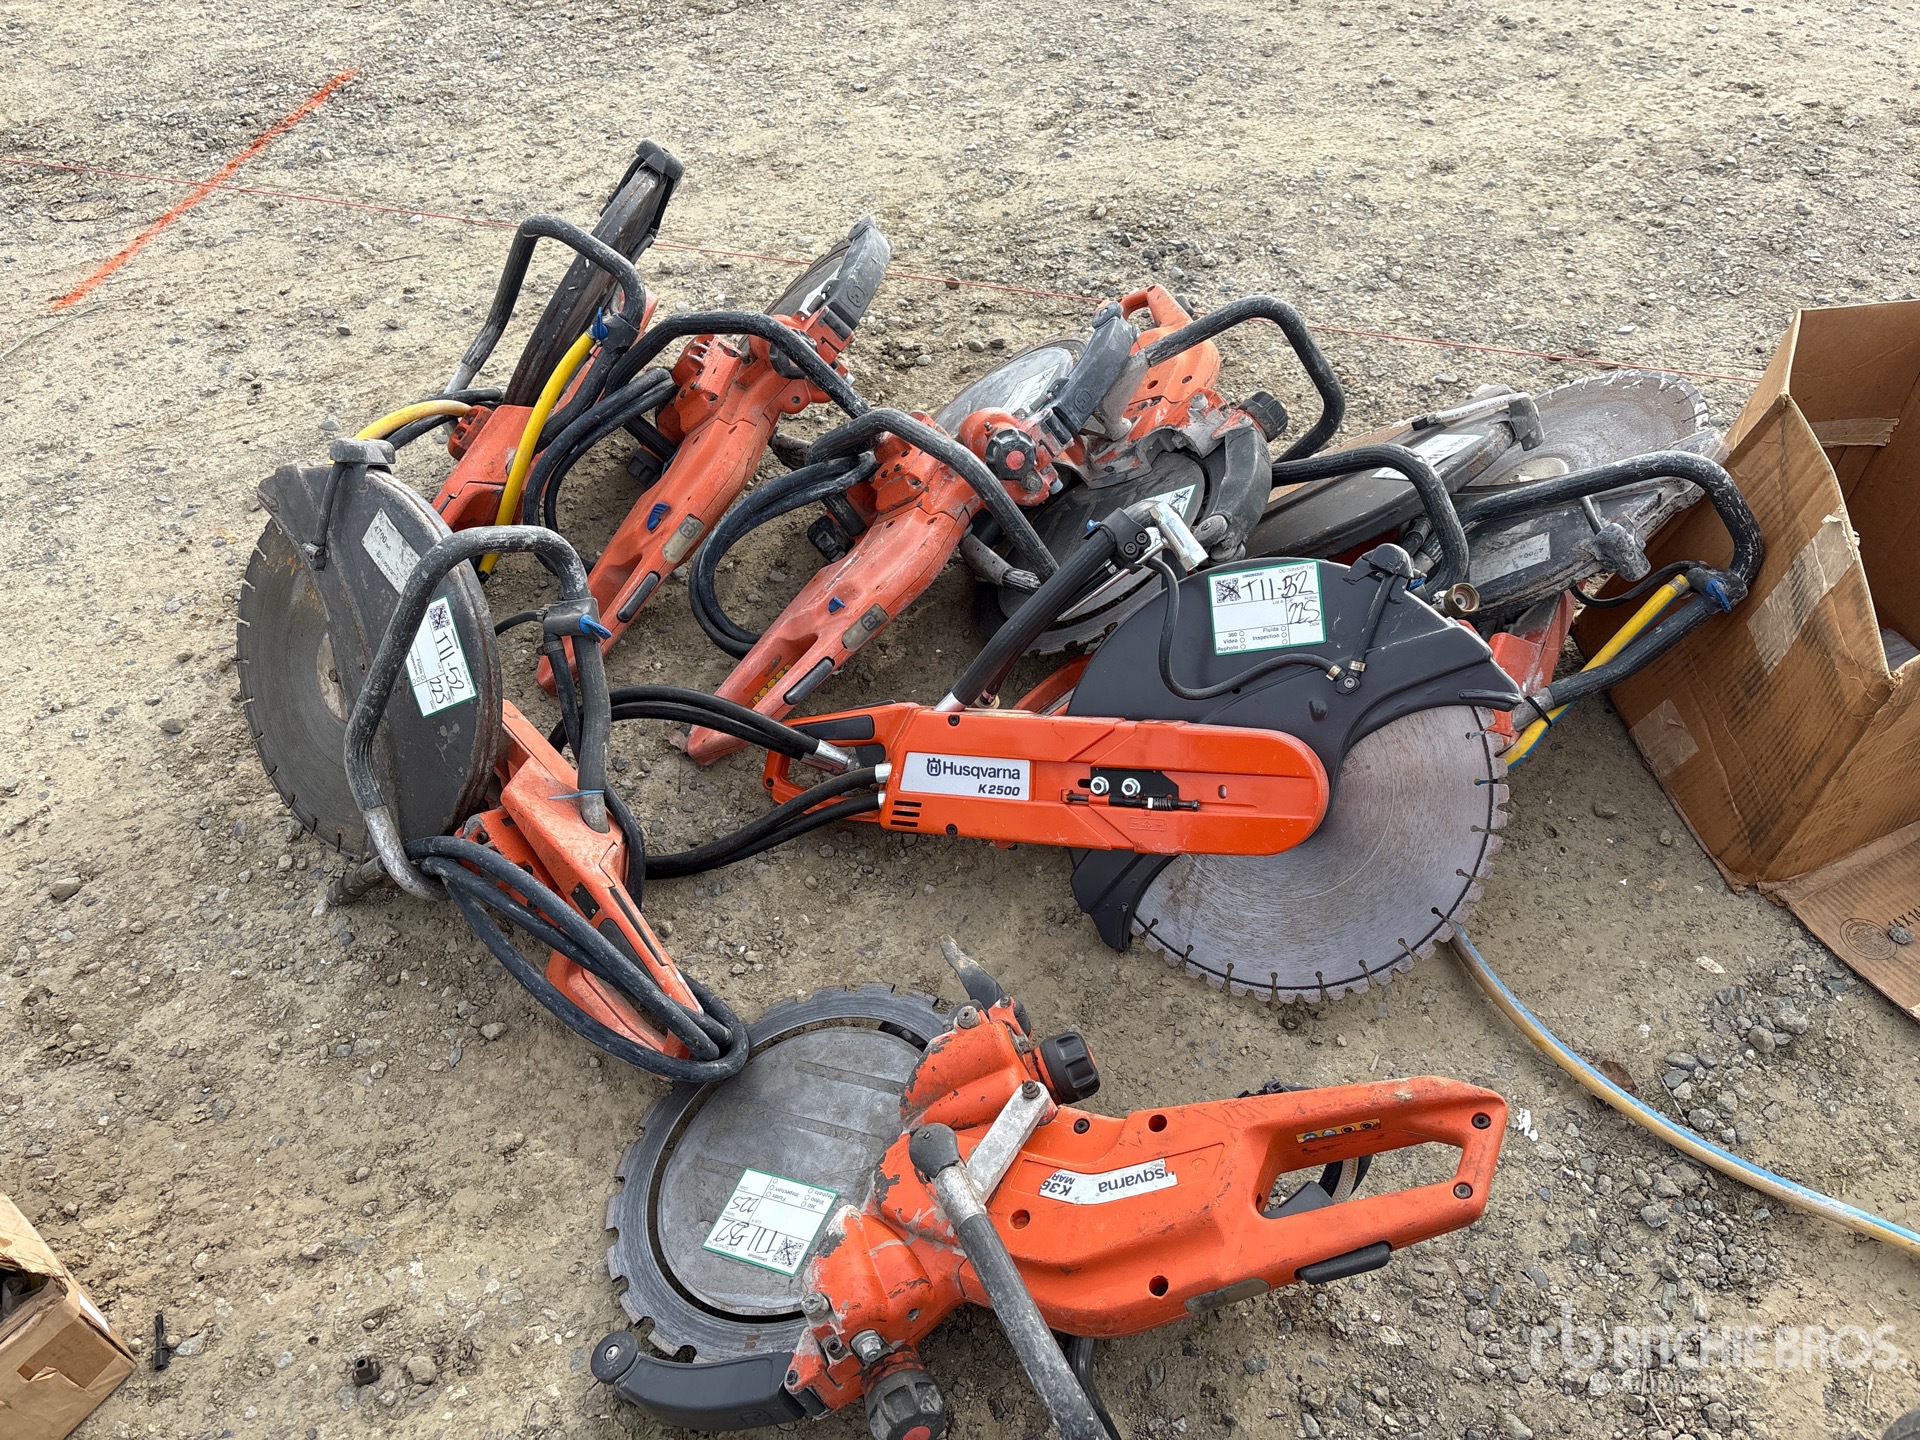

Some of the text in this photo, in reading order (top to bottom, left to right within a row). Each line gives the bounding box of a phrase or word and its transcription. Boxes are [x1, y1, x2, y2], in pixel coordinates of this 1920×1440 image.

[436, 631, 464, 696] T11-52
[942, 761, 1020, 780] Husqvarna
[774, 1186, 800, 1198] Inspection
[814, 1189, 834, 1199] Rephoto
[810, 1197, 824, 1205] Video
